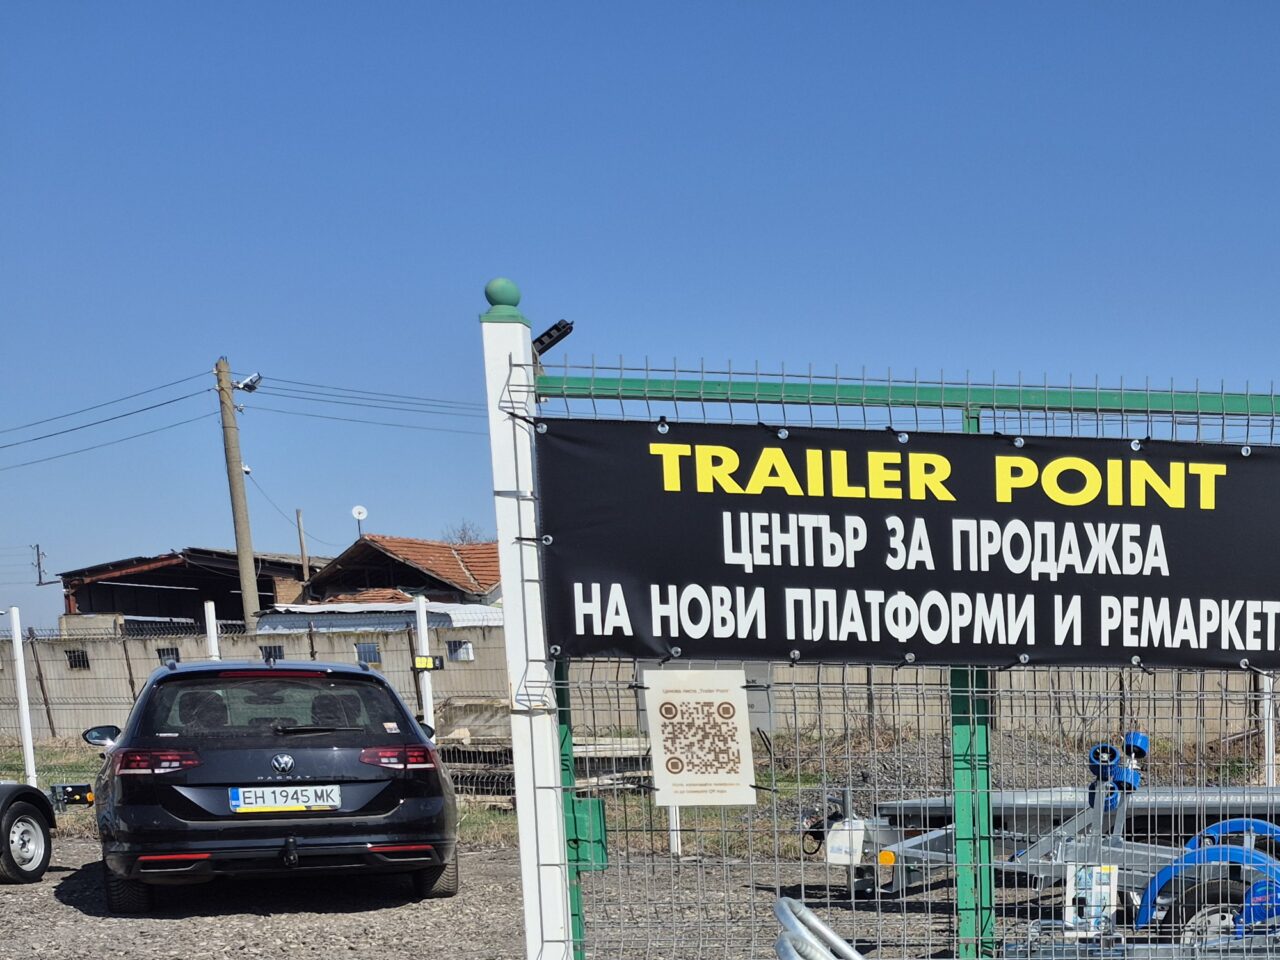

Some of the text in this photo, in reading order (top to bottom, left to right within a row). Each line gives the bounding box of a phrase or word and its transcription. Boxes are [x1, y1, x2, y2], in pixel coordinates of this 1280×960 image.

[649, 442, 1227, 510] TRAILER POINT
[722, 511, 1170, 582] ЦЕНТЪР ЗА ПРОДАЖБА
[573, 582, 634, 636] НА
[650, 583, 767, 640] НОВИ
[784, 587, 1036, 646] ПЛАТФОРМИ
[1054, 594, 1082, 646] И
[242, 788, 336, 805] EH 1945 MK
